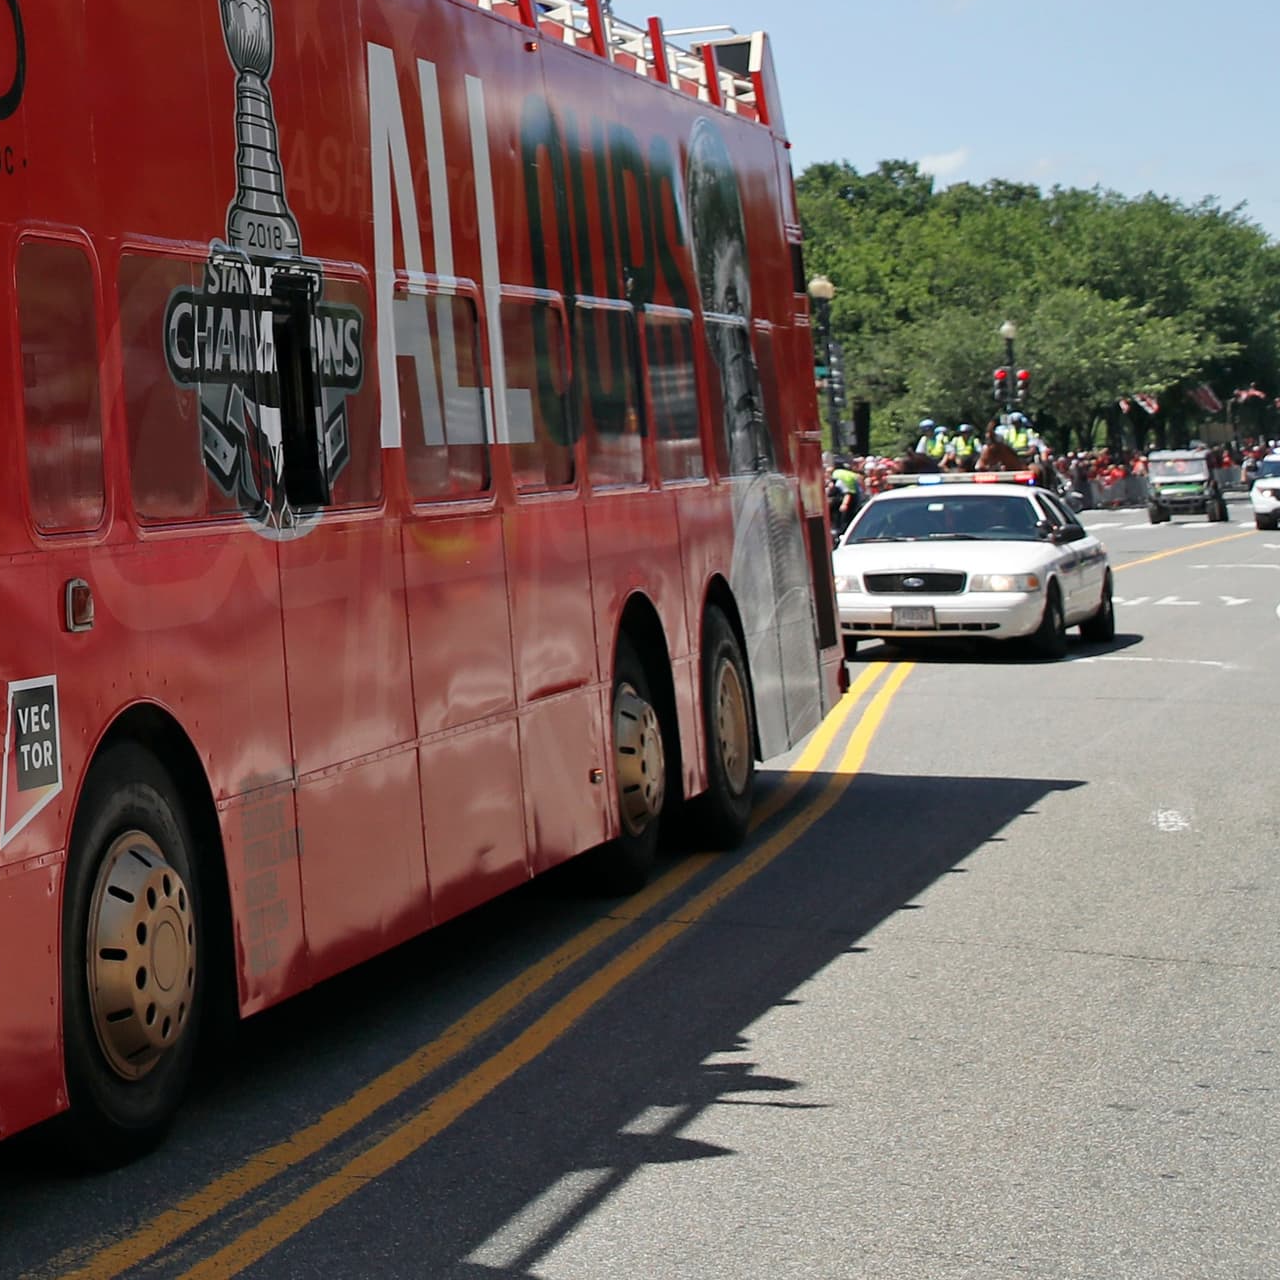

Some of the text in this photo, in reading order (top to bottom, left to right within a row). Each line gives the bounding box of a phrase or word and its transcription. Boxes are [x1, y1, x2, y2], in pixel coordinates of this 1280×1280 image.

[247, 221, 282, 251] 2018
[367, 41, 696, 449] ALL OURS
[169, 302, 360, 377] CHAMNS
[18, 704, 51, 735] VEC
[20, 740, 53, 771] TOR
